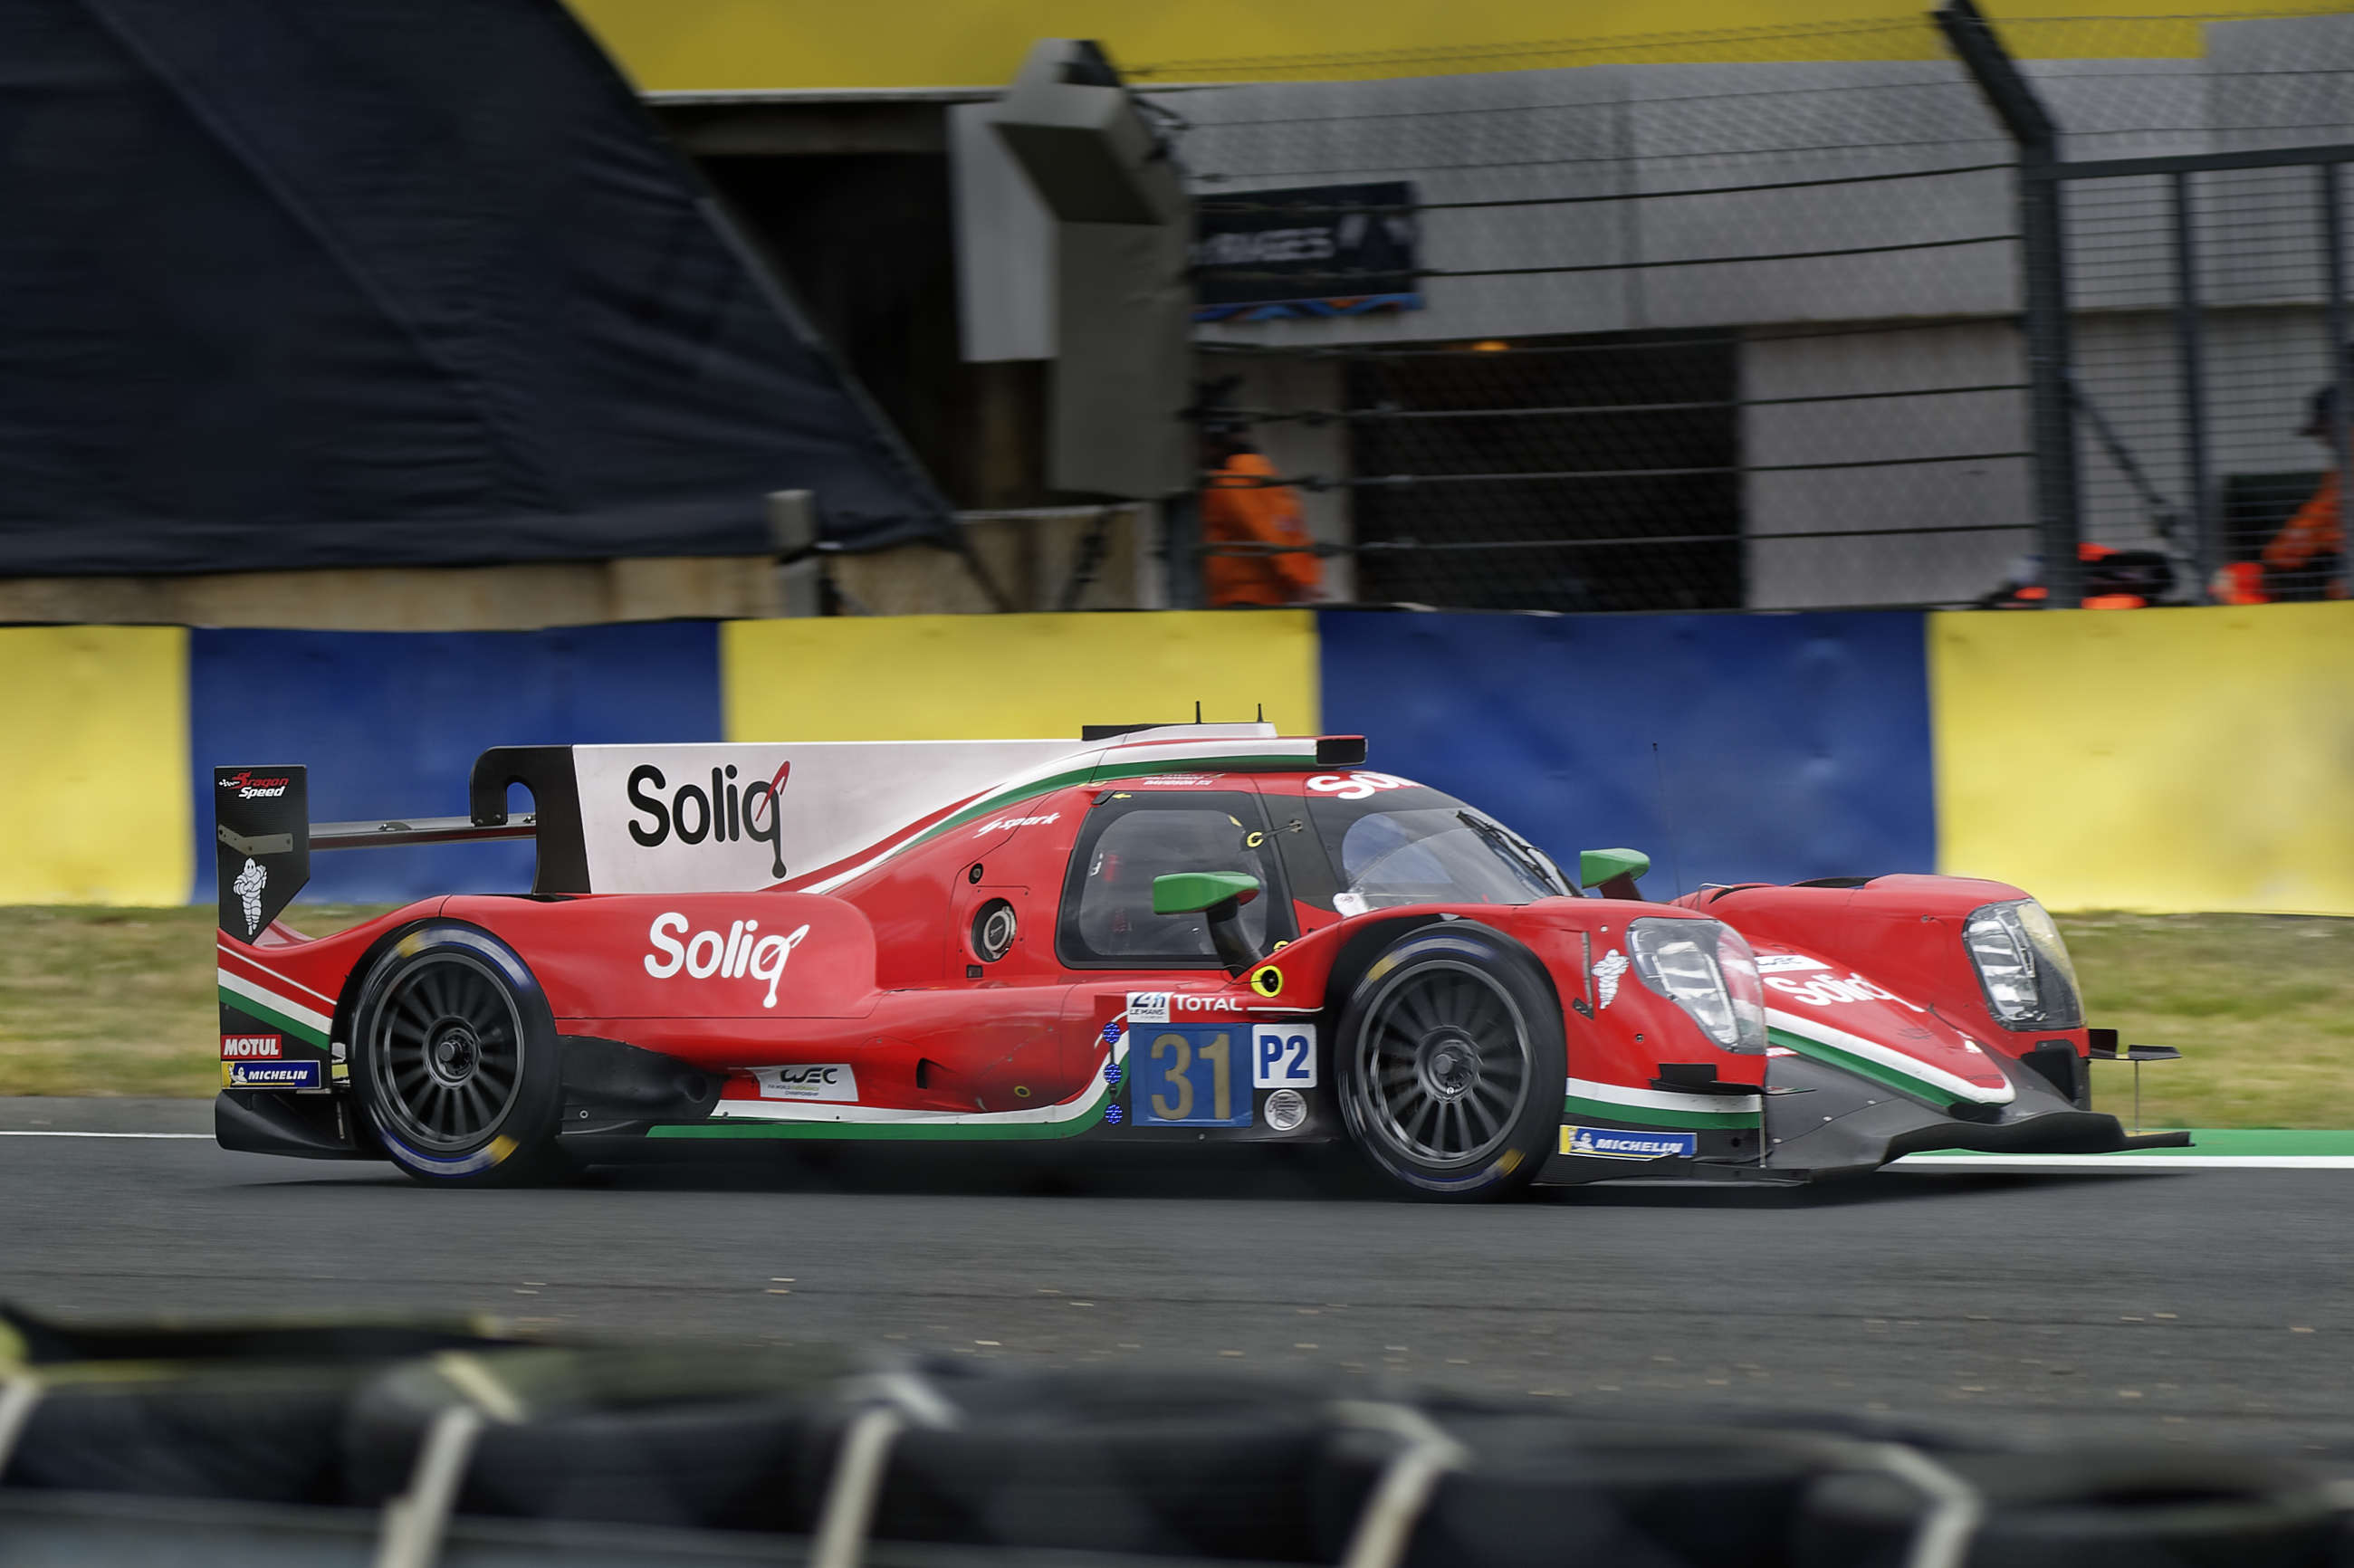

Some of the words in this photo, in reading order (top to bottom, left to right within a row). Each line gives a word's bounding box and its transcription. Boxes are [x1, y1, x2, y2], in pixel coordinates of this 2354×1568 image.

[230, 771, 290, 789] Dragon
[238, 785, 286, 799] Speed
[627, 760, 791, 879] Soliq
[644, 912, 810, 1009] Soliq
[1172, 994, 1244, 1011] TOTAL
[223, 1037, 280, 1056] MOTUL
[1259, 1035, 1311, 1080] P2
[248, 1070, 309, 1081] MICHELIN
[780, 1066, 838, 1085] WEC
[1151, 1033, 1232, 1121] 31
[1595, 1138, 1684, 1153] MICHELIN
